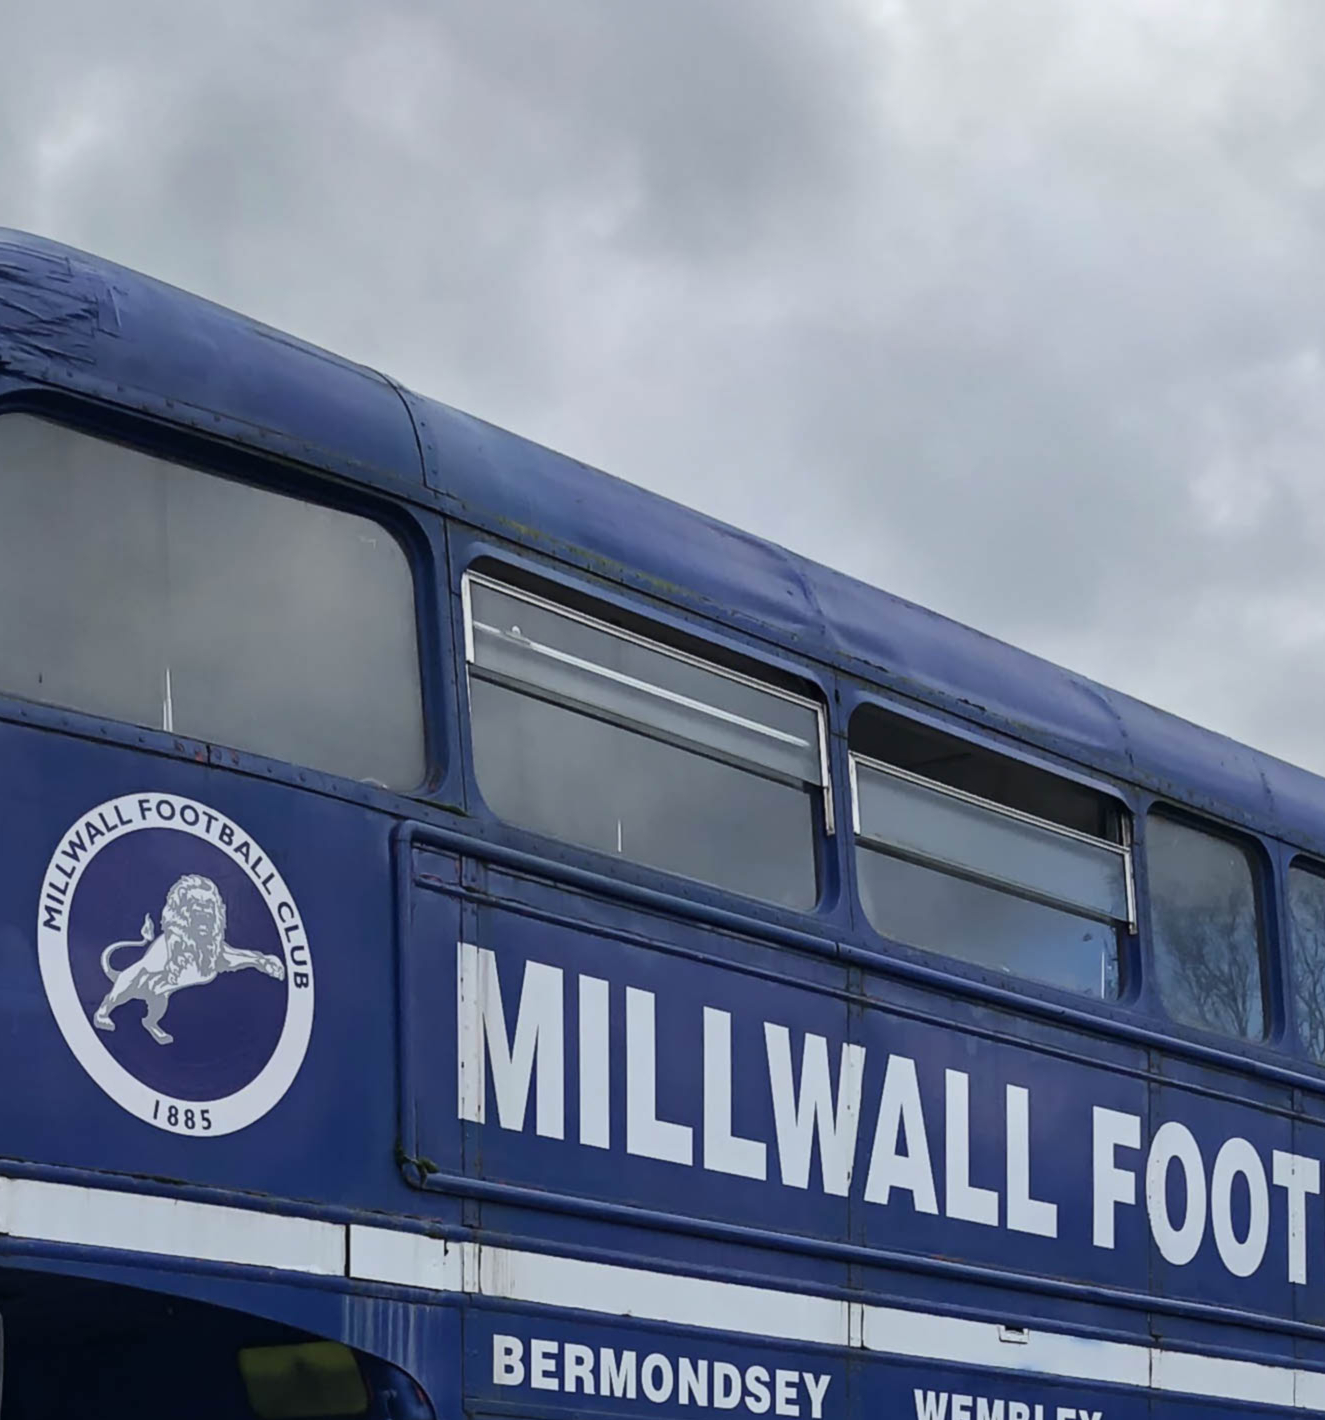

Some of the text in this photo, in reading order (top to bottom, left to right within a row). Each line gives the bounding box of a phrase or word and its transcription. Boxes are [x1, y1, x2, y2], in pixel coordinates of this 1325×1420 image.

[43, 799, 309, 989] MILLWALL FOOTBALL CLUB
[153, 1099, 212, 1130] 1885
[457, 942, 1058, 1238] MILLWALL
[492, 1334, 831, 1419] BERMONDSEY
